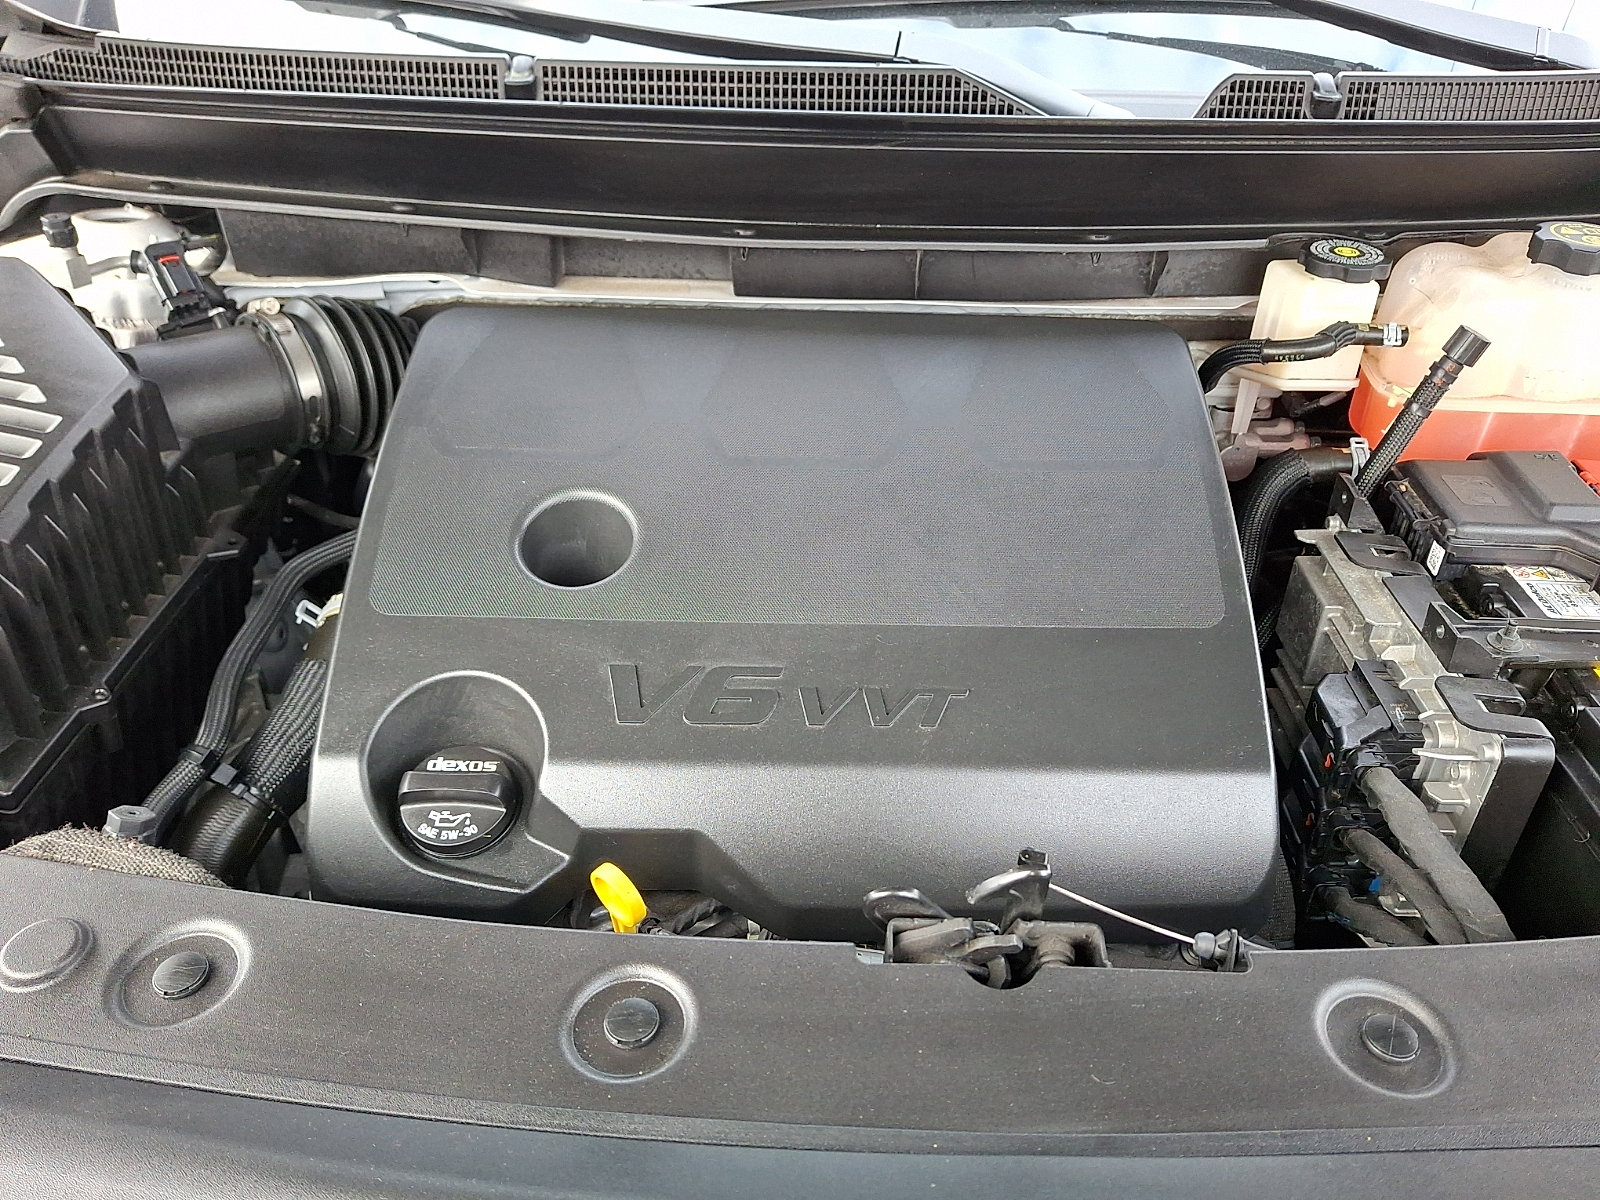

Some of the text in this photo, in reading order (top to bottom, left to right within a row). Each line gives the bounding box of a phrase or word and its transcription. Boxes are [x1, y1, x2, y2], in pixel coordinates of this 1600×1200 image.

[608, 663, 971, 729] V6 VVT
[426, 756, 499, 772] dexos
[417, 823, 479, 841] SAE 5W-30
